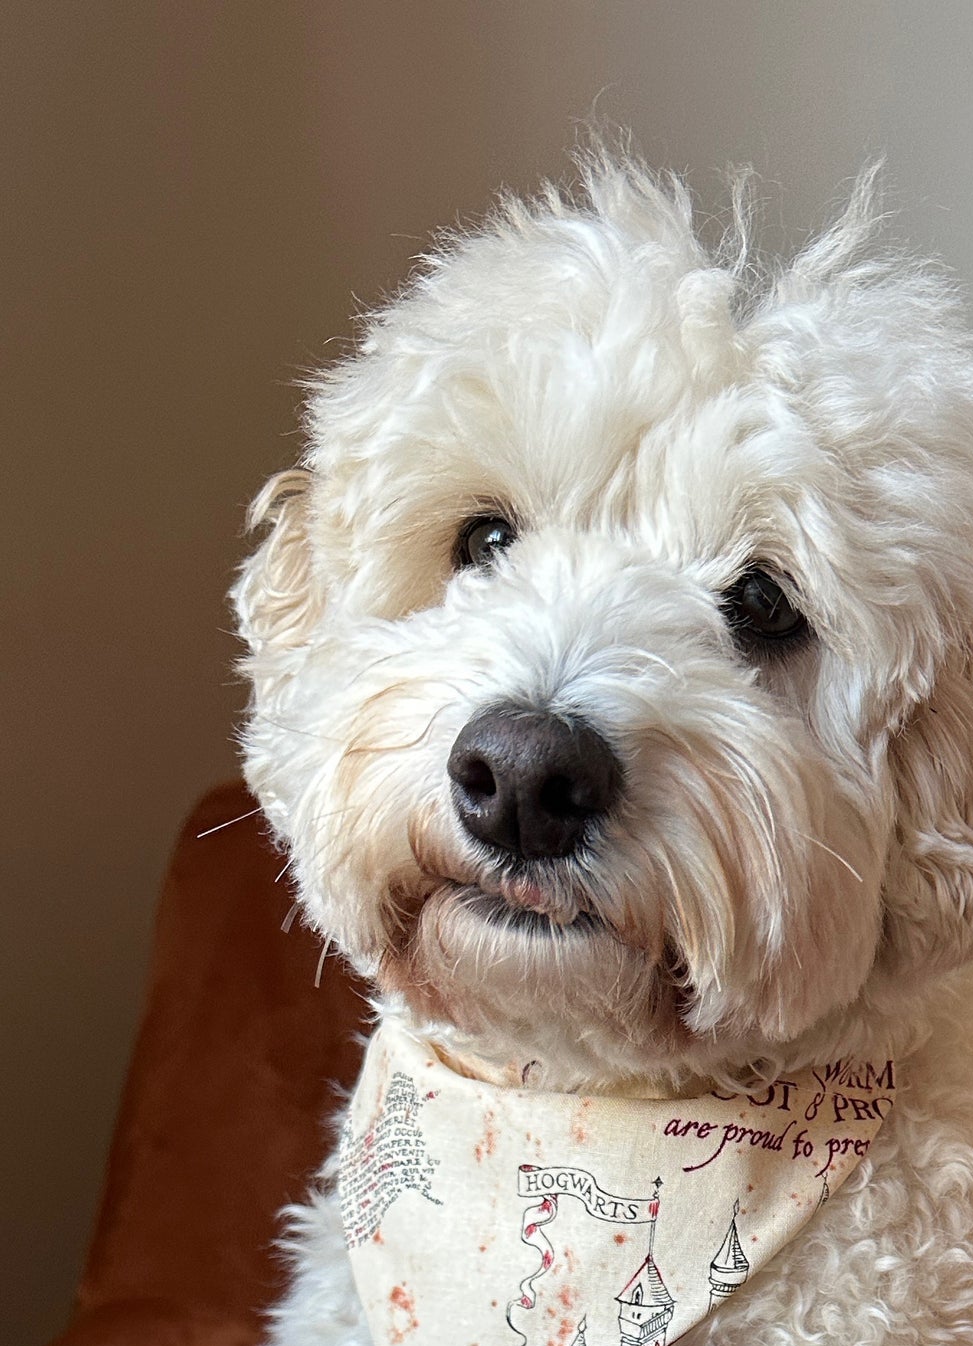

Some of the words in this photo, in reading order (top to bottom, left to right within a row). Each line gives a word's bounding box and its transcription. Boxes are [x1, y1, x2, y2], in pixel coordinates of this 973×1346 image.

[664, 1118, 718, 1138] are
[682, 1120, 797, 1172] proud
[791, 1129, 814, 1160] to
[525, 1172, 640, 1221] HOGWARTS
